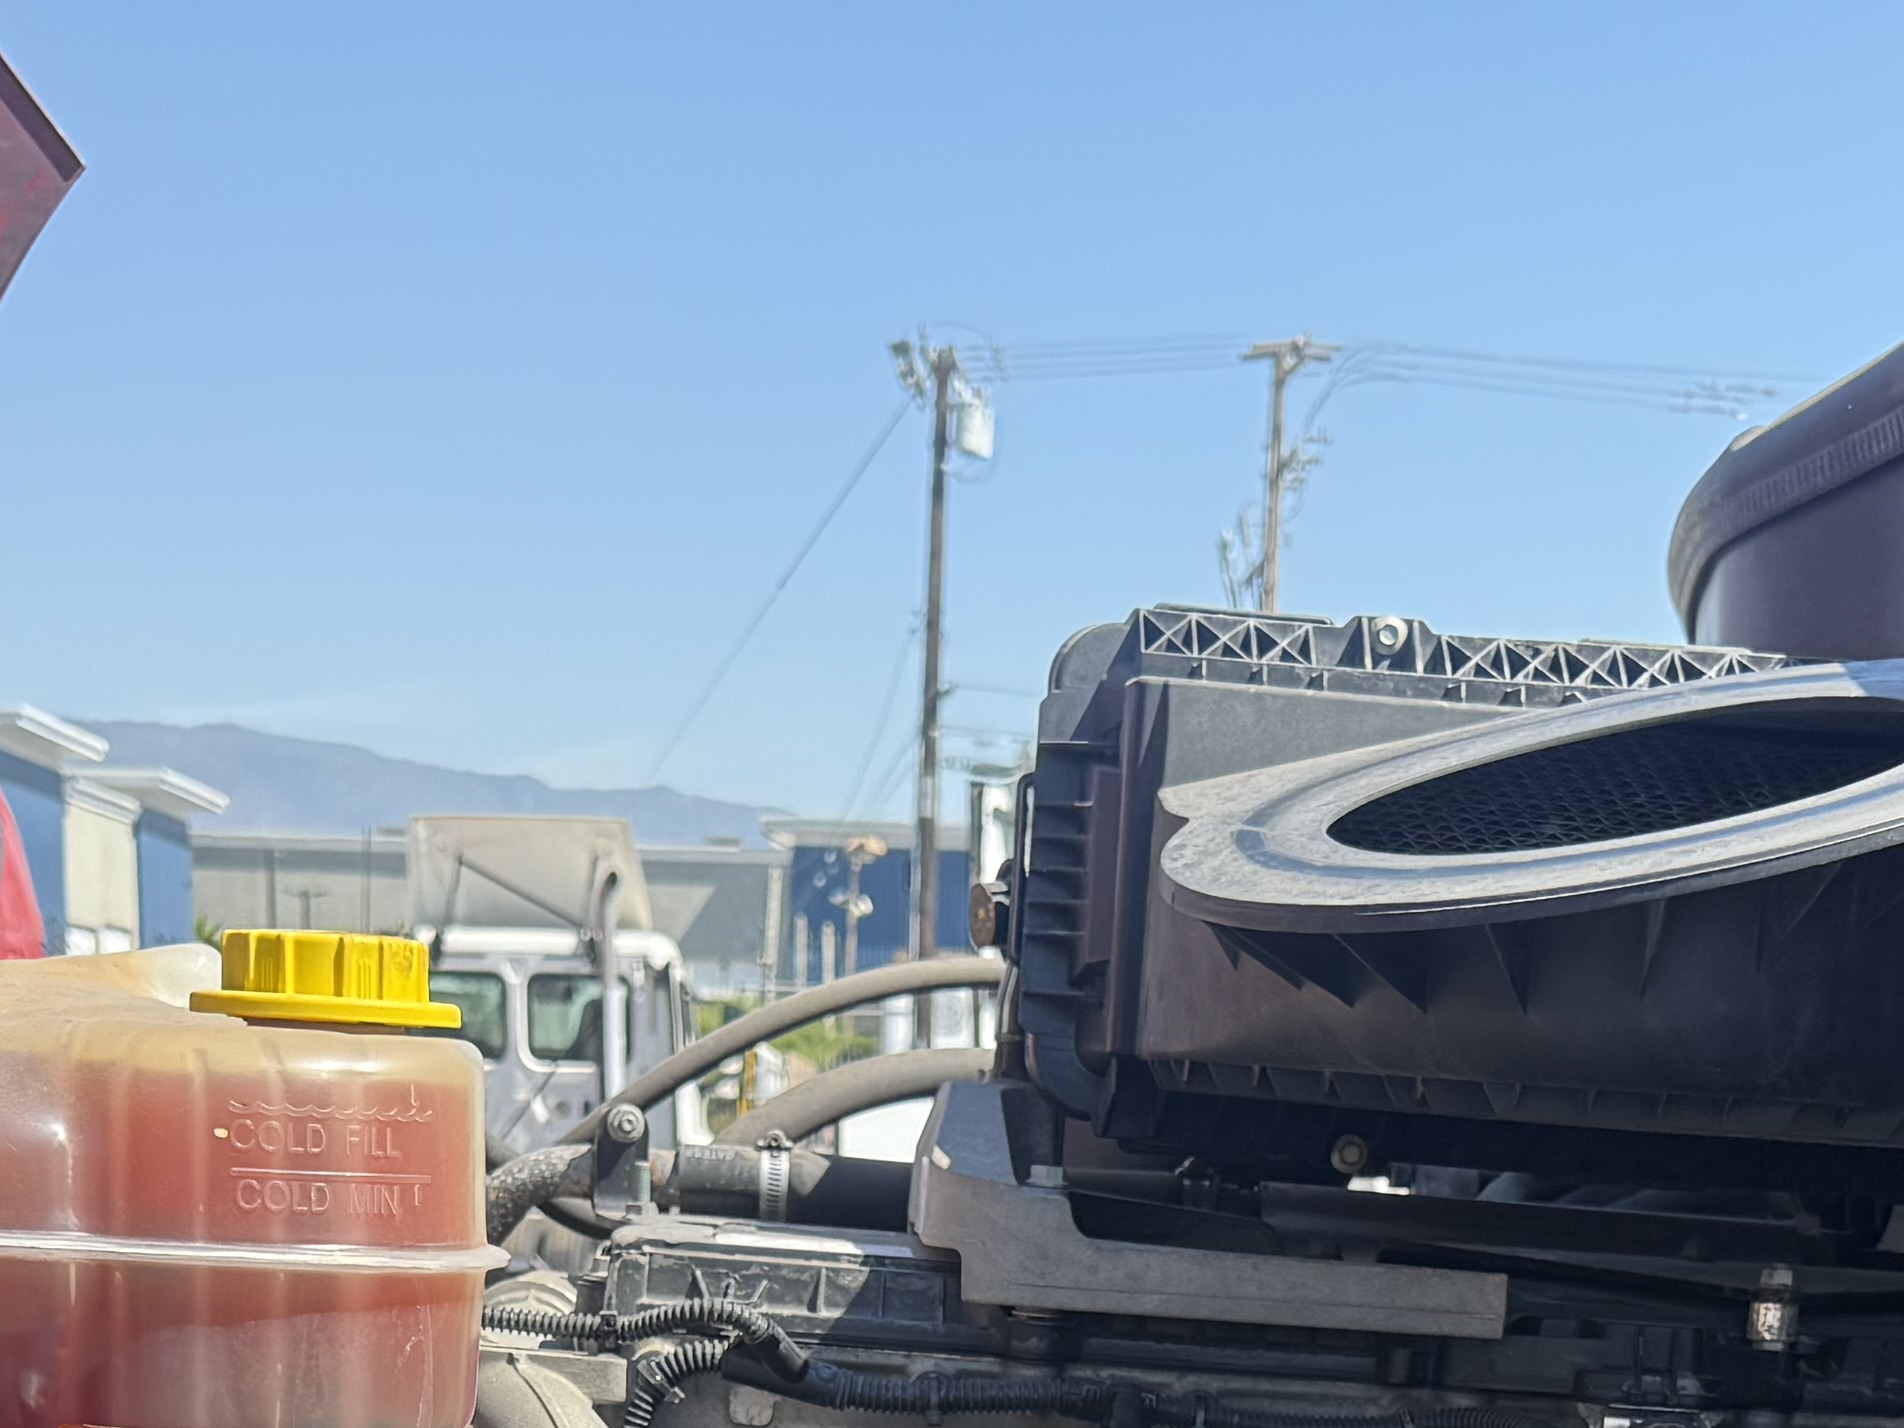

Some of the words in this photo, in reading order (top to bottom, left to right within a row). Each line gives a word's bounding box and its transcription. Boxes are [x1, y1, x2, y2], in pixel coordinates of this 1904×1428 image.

[229, 1118, 325, 1154] COLD
[347, 1126, 400, 1158] FILL
[236, 1178, 330, 1213] COLD
[349, 1184, 400, 1217] MIN
